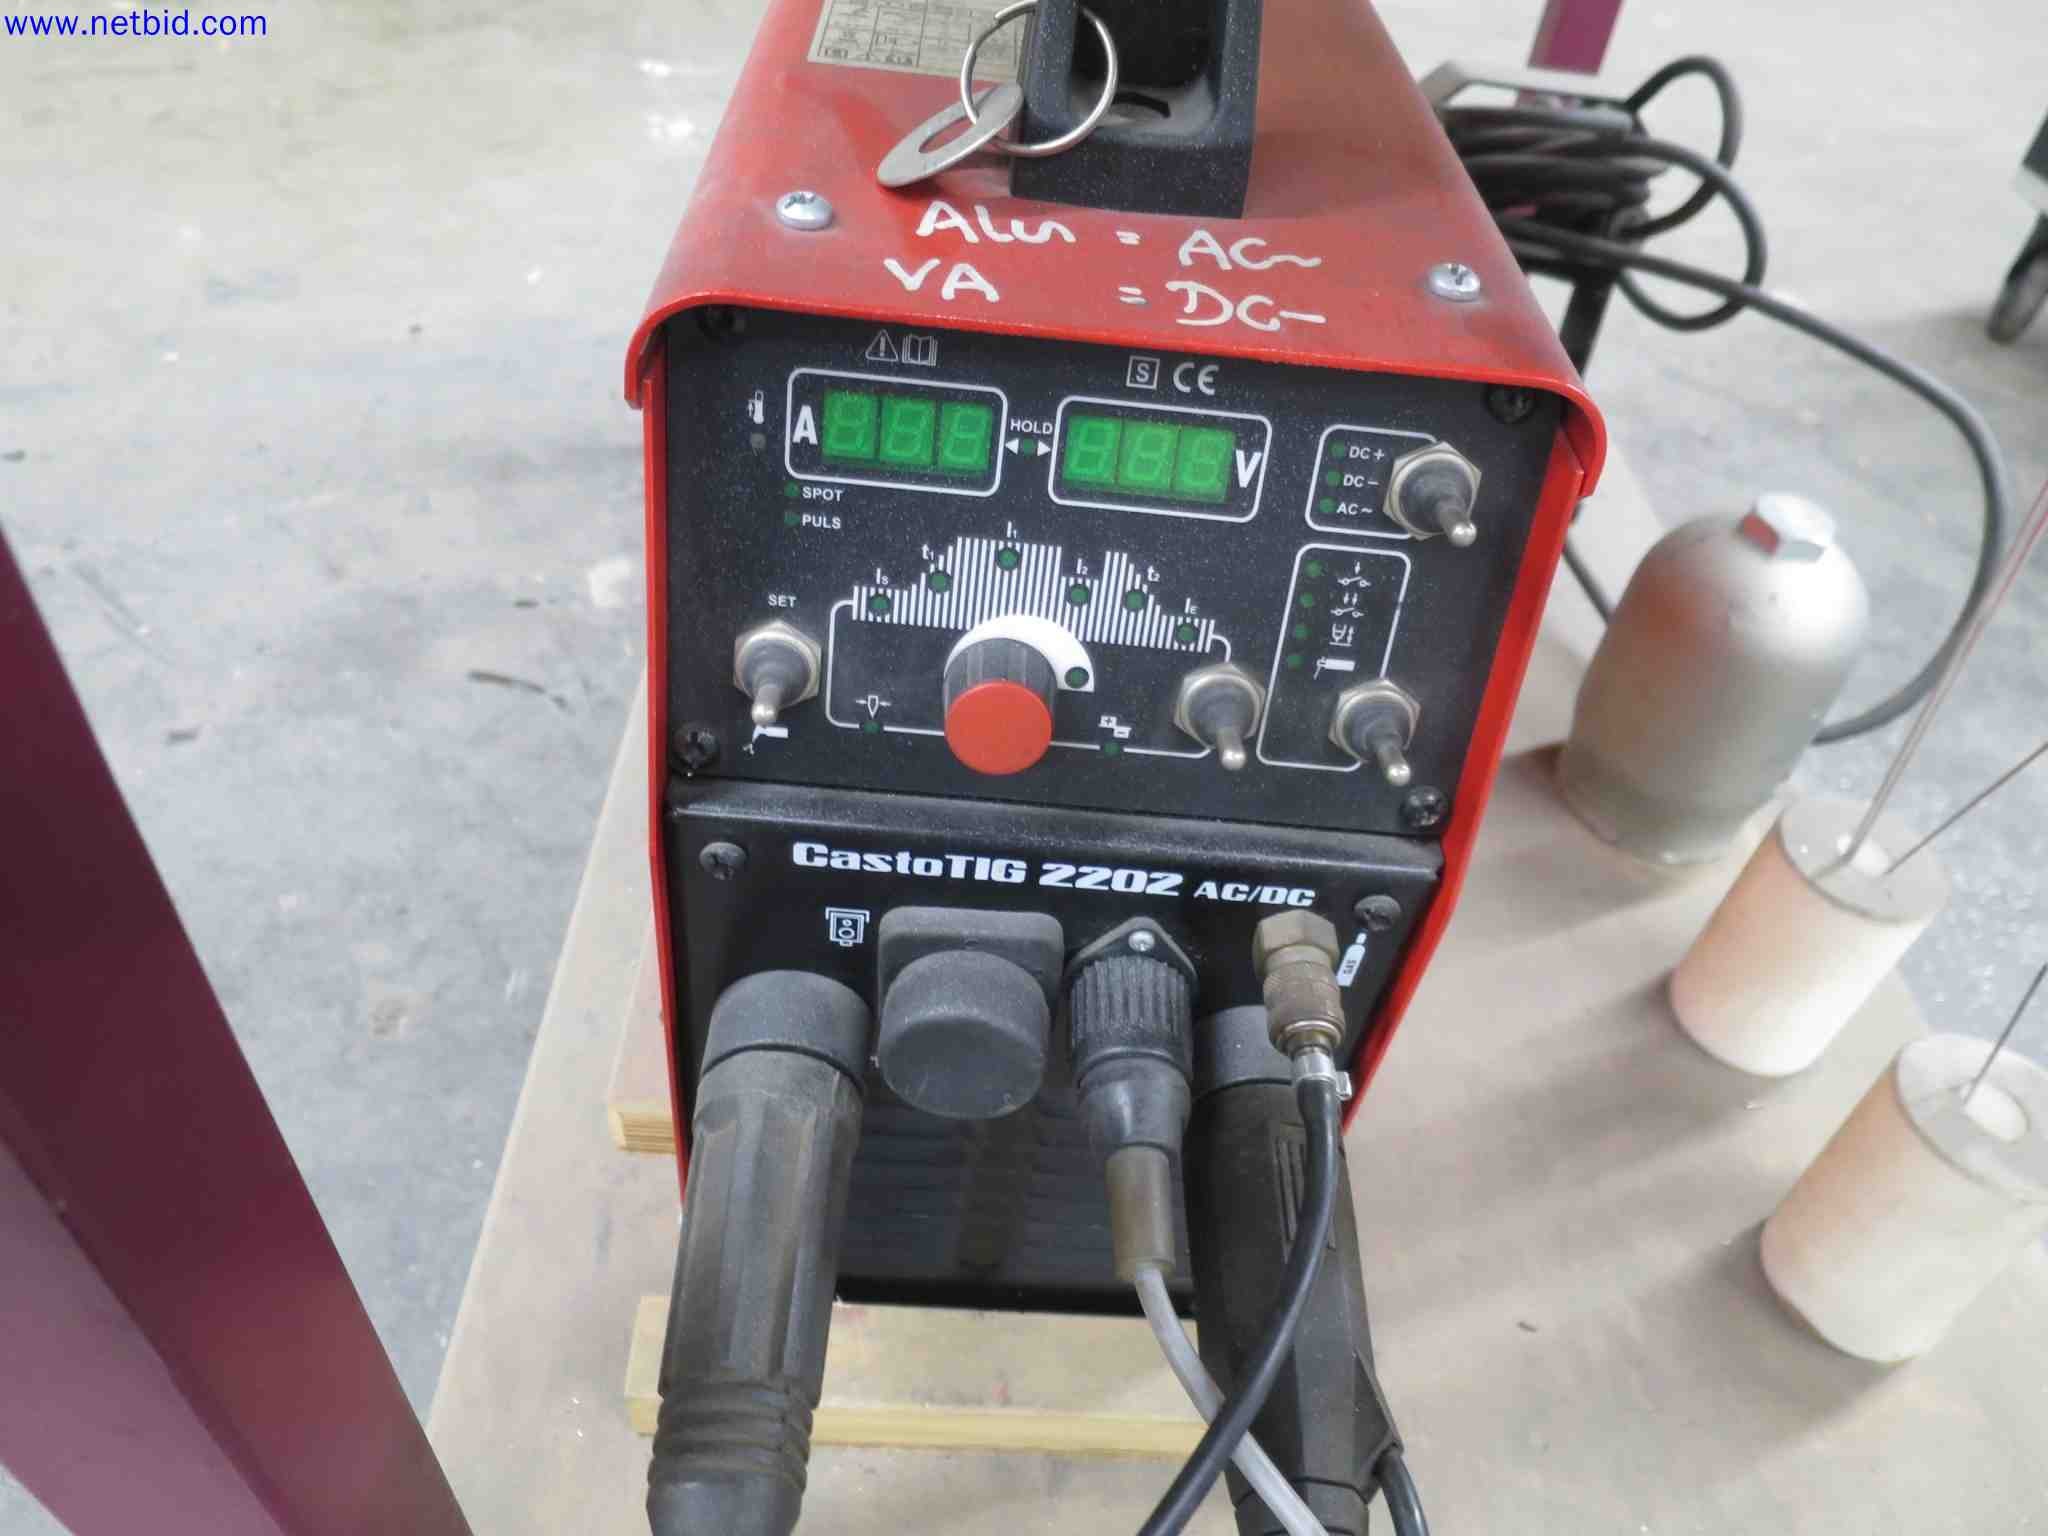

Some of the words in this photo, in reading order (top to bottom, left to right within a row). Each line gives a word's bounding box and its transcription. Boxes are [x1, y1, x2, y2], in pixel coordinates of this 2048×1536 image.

[883, 258, 1000, 303] VA
[792, 405, 818, 445] A
[1010, 418, 1053, 435] HOLD
[1235, 449, 1262, 488] V
[802, 487, 844, 501] SPOT
[802, 514, 841, 529] PULS
[768, 594, 796, 609] SET
[792, 842, 1027, 884] CastoTIG
[1039, 862, 1184, 897] 2202
[1193, 881, 1316, 907] AC/DC
